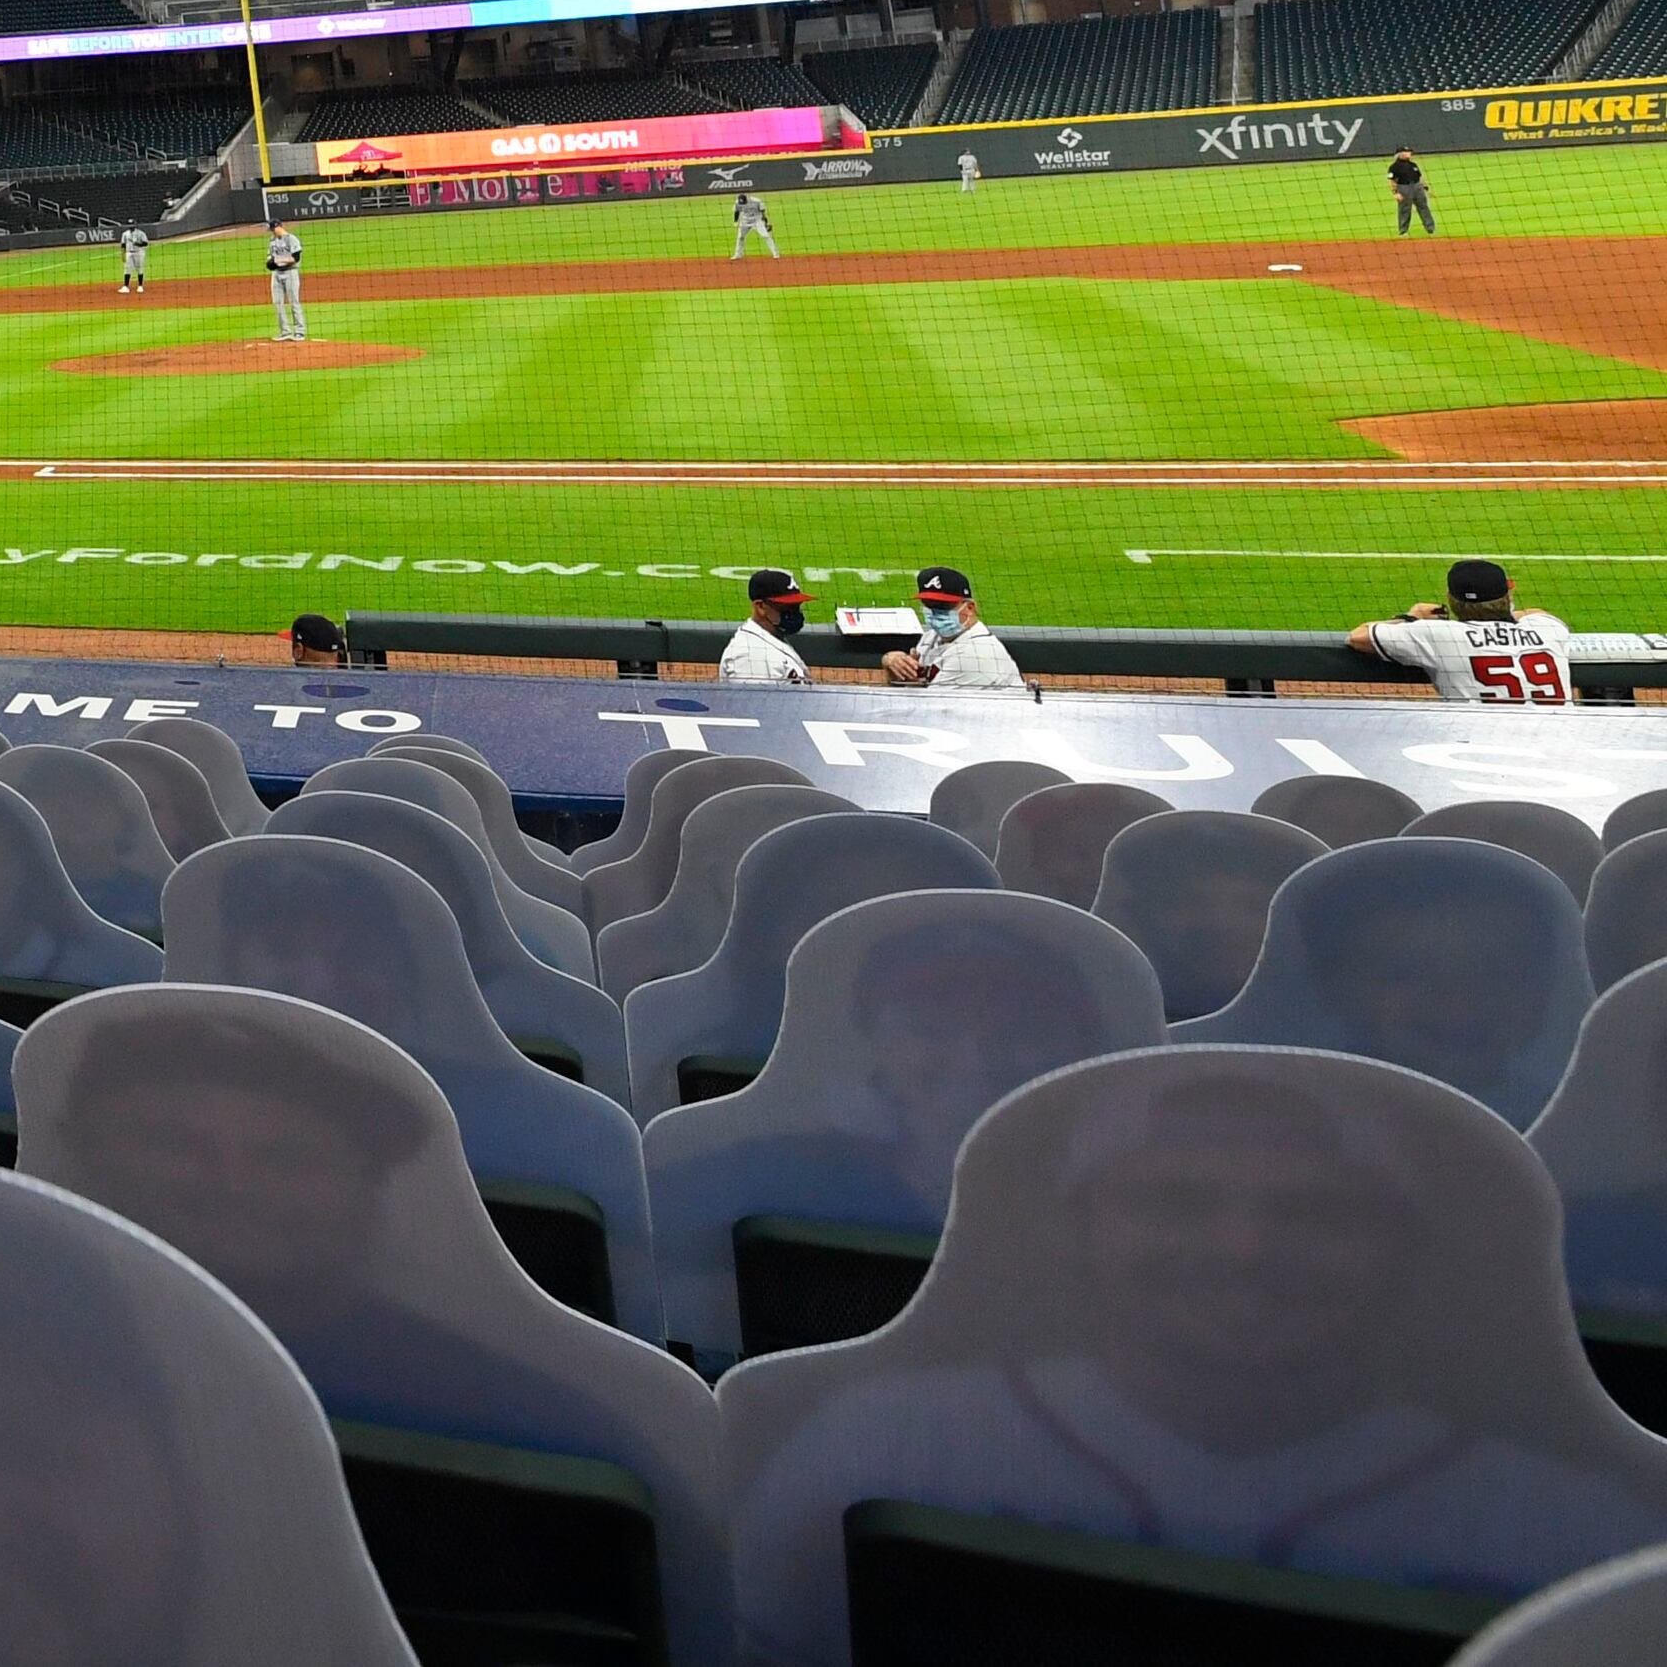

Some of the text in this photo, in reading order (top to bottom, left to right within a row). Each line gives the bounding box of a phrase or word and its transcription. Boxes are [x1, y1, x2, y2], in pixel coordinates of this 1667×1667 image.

[1441, 98, 1476, 112] 385
[1196, 112, 1365, 161] xfinity
[1503, 130, 1544, 141] What
[1549, 124, 1626, 139] America's
[491, 130, 639, 156] GAS SOUTH
[873, 137, 903, 149] 375
[1034, 149, 1111, 165] Wellstar
[820, 160, 861, 174] ARROW
[268, 194, 289, 204] 335
[294, 203, 357, 216] INFINITI
[88, 229, 116, 242] WISE
[1466, 628, 1544, 648] CASTRO
[1470, 651, 1566, 706] 59
[254, 703, 424, 734] TO
